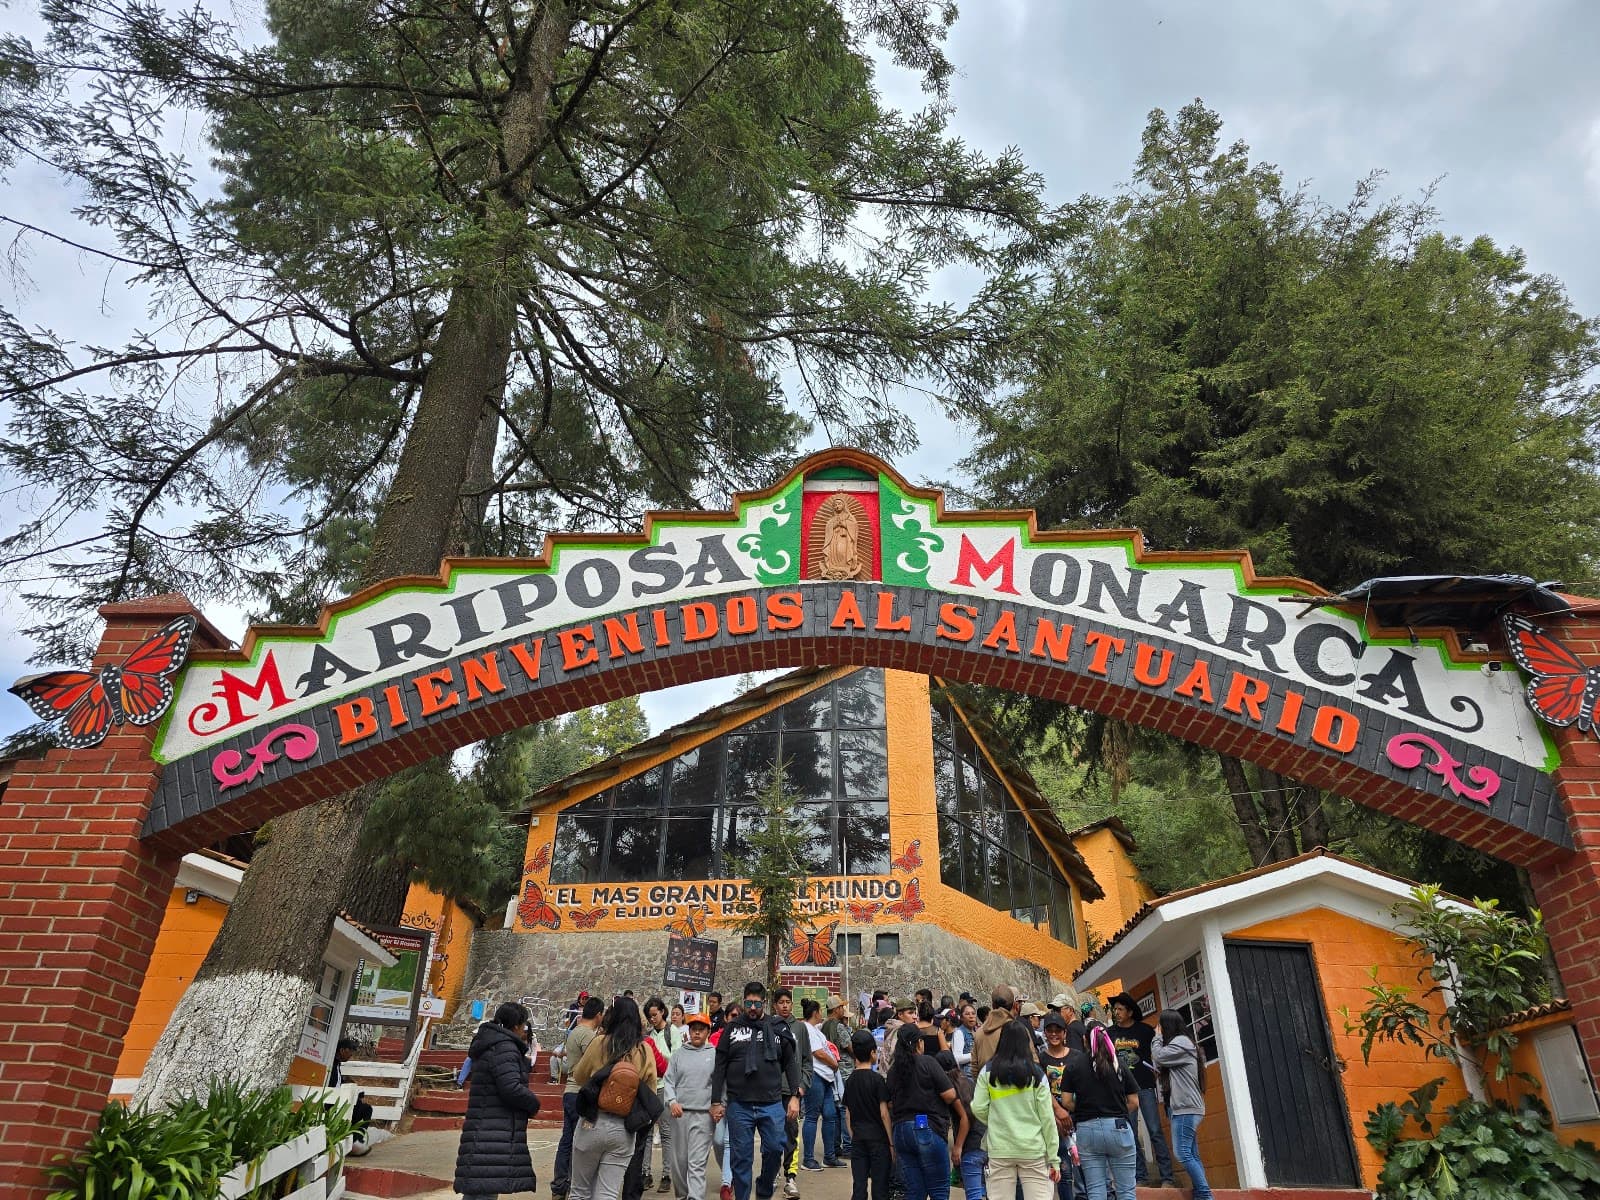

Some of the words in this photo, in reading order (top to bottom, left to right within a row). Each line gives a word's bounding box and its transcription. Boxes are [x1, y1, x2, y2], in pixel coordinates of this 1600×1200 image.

[188, 533, 752, 737] MARIPOSA
[949, 532, 1483, 733] MONARCA
[332, 592, 805, 747] BIENVENIDOS
[831, 592, 912, 632] AL
[936, 603, 1361, 754] SANTUARIO
[592, 886, 639, 905] MAS
[648, 883, 752, 906] GRANDE
[816, 879, 902, 901] MUNDO
[614, 905, 676, 919] EJIDO
